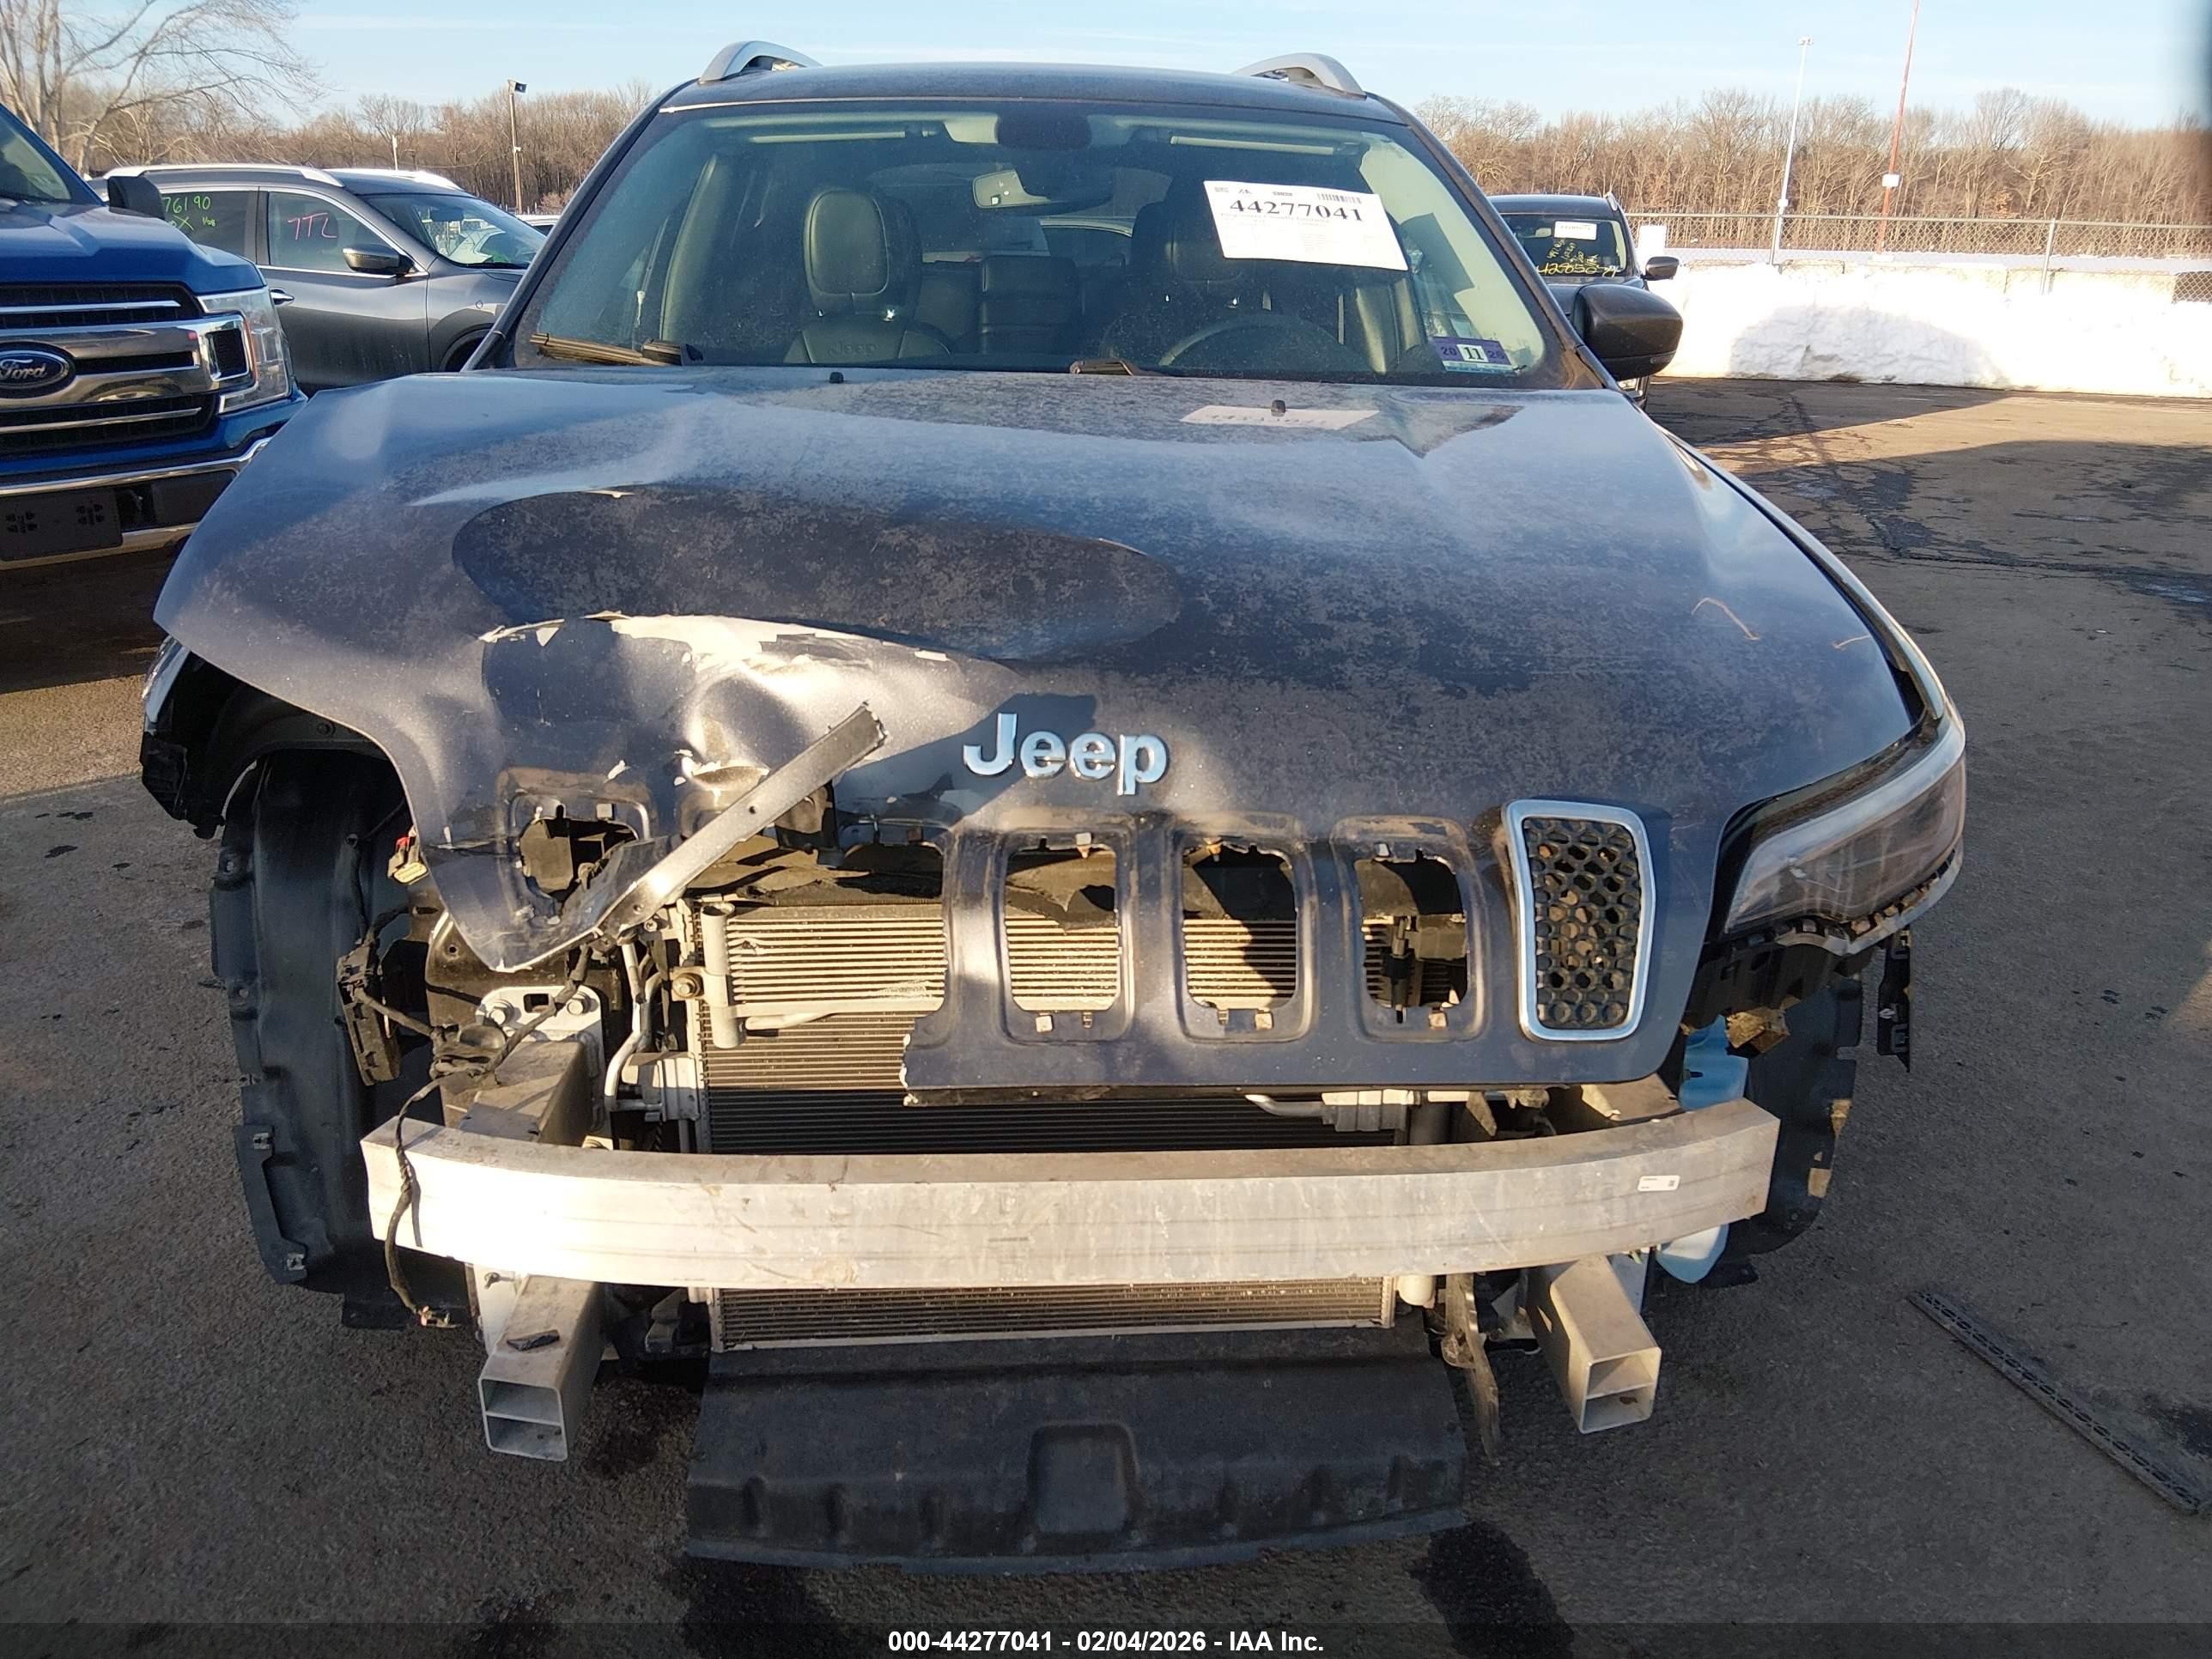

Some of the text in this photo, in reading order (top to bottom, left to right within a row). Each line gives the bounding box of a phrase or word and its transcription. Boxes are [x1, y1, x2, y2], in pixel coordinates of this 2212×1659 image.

[1230, 199, 1363, 222] 44277041
[1441, 346, 1457, 356] 20
[1464, 347, 1484, 361] 11
[0, 358, 47, 380] Ford
[963, 713, 1167, 796] Jeep
